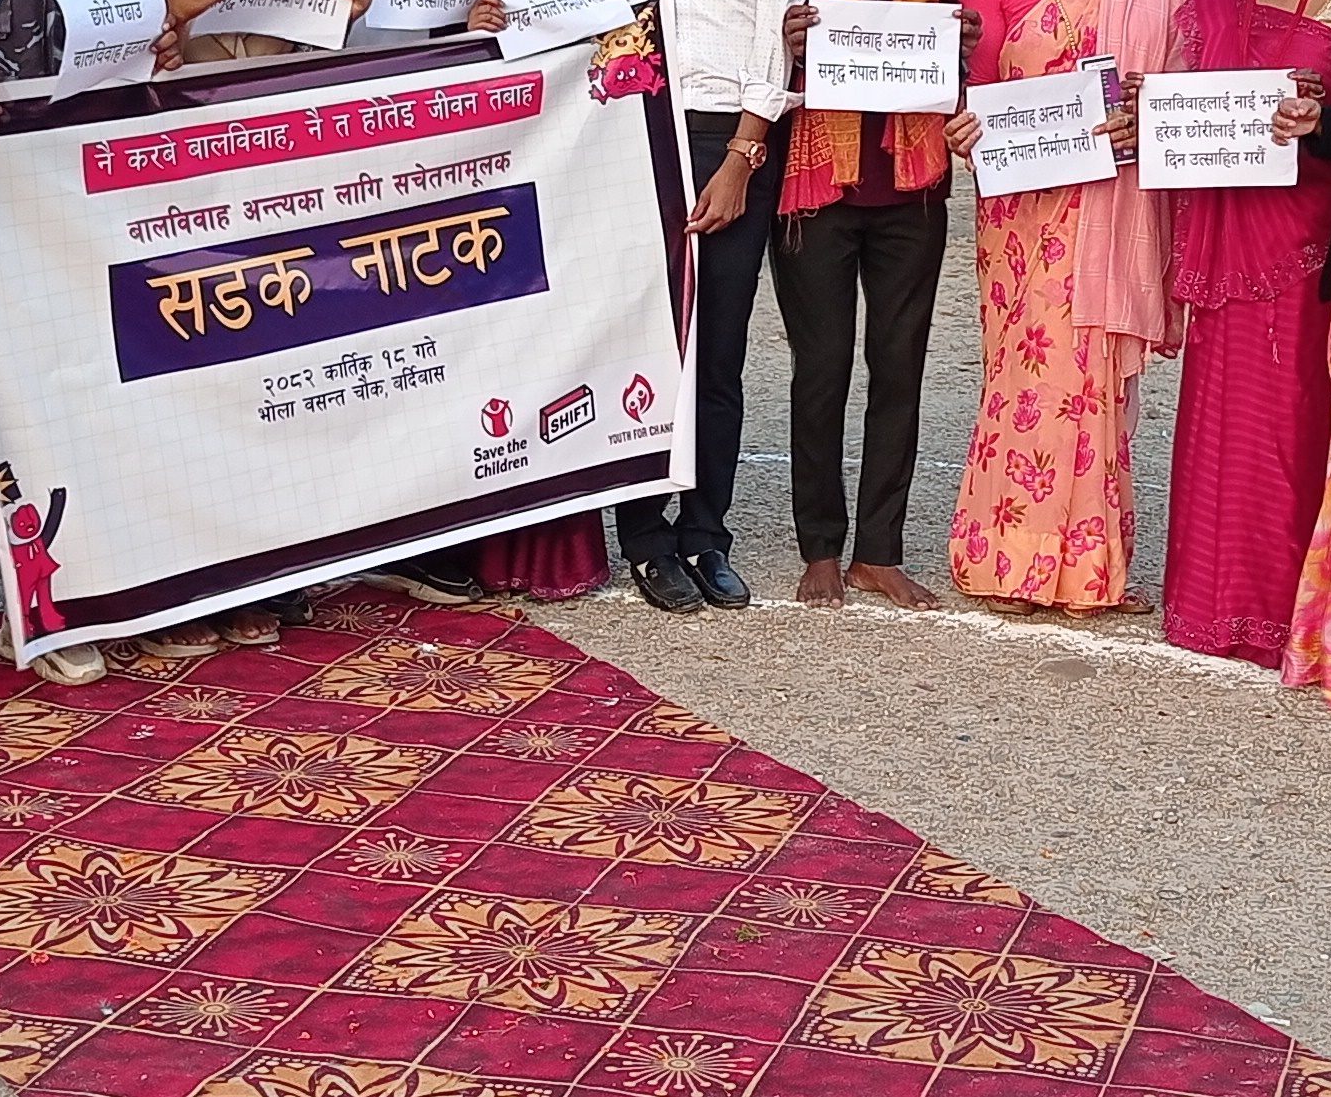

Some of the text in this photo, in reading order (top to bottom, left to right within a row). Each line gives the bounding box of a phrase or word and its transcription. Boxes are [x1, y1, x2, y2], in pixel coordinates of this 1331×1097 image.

[849, 59, 879, 82] नेपाल
[882, 61, 916, 84] निर्माण
[332, 112, 352, 135] त
[426, 89, 479, 123] जीवन
[488, 82, 536, 111] तबाह
[1155, 119, 1236, 143] हरेक छोरीलाई
[1009, 134, 1071, 162] नेपाल निर्माण
[1165, 148, 1185, 170] दिन
[1189, 147, 1240, 168] उत्साहित
[126, 202, 231, 245] बालविवाह
[334, 172, 383, 207] लागि
[392, 150, 513, 197] सचेतनामूलक
[145, 205, 511, 342] सडक नाटक
[262, 334, 437, 396] २०८२ कार्तिक १८ गते
[257, 395, 296, 425] भोला
[549, 400, 591, 435] SHIFT
[608, 431, 632, 446] YOUTH
[633, 427, 648, 439] FOR
[473, 438, 528, 464] Save the
[474, 454, 529, 480] Children
